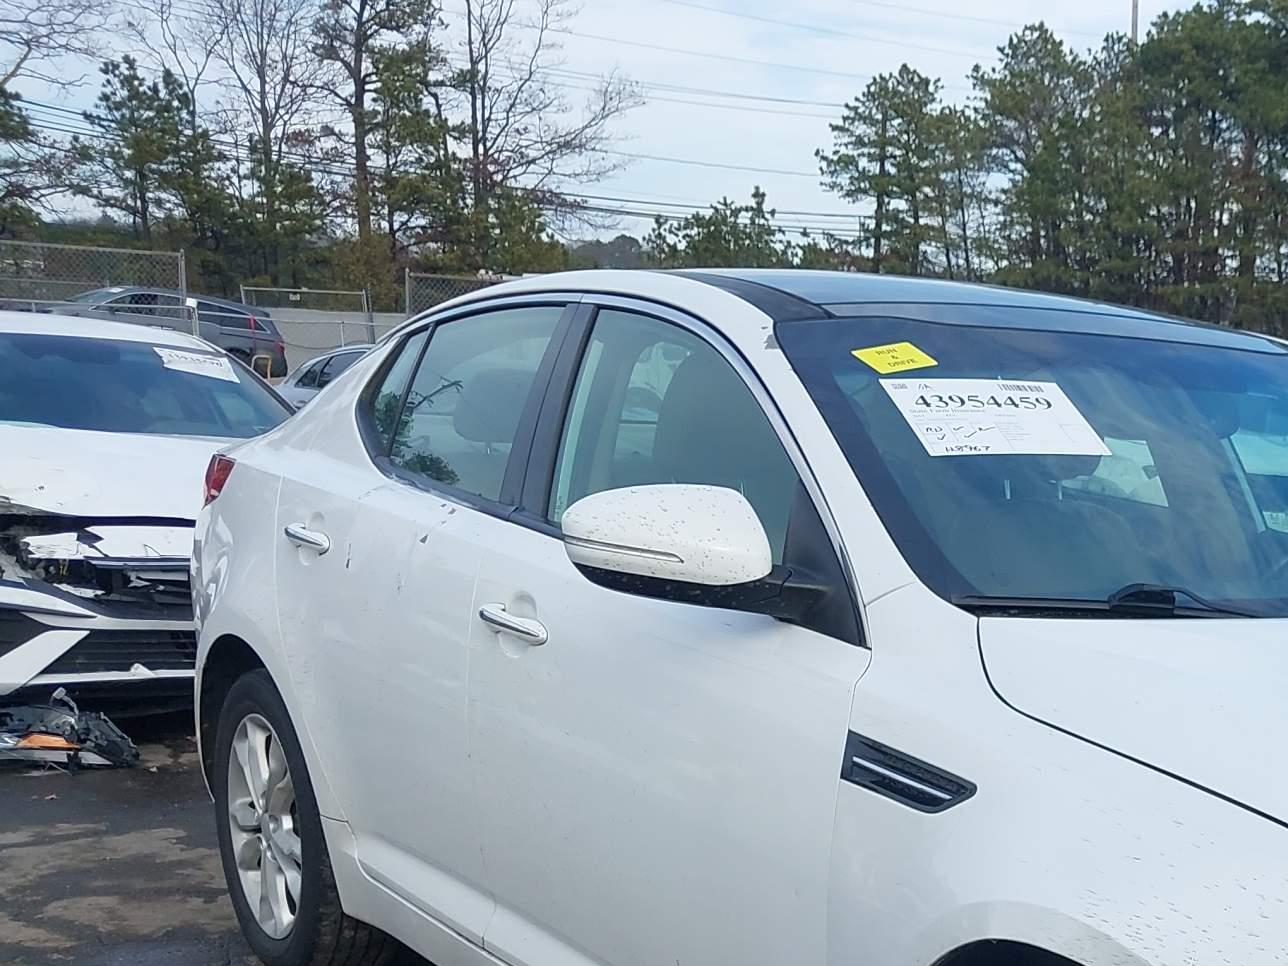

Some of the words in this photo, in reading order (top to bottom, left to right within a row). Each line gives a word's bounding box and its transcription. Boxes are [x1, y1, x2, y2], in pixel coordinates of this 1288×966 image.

[875, 347, 898, 356] RUN
[887, 358, 918, 368] DRIVE
[915, 394, 1053, 410] 43954459
